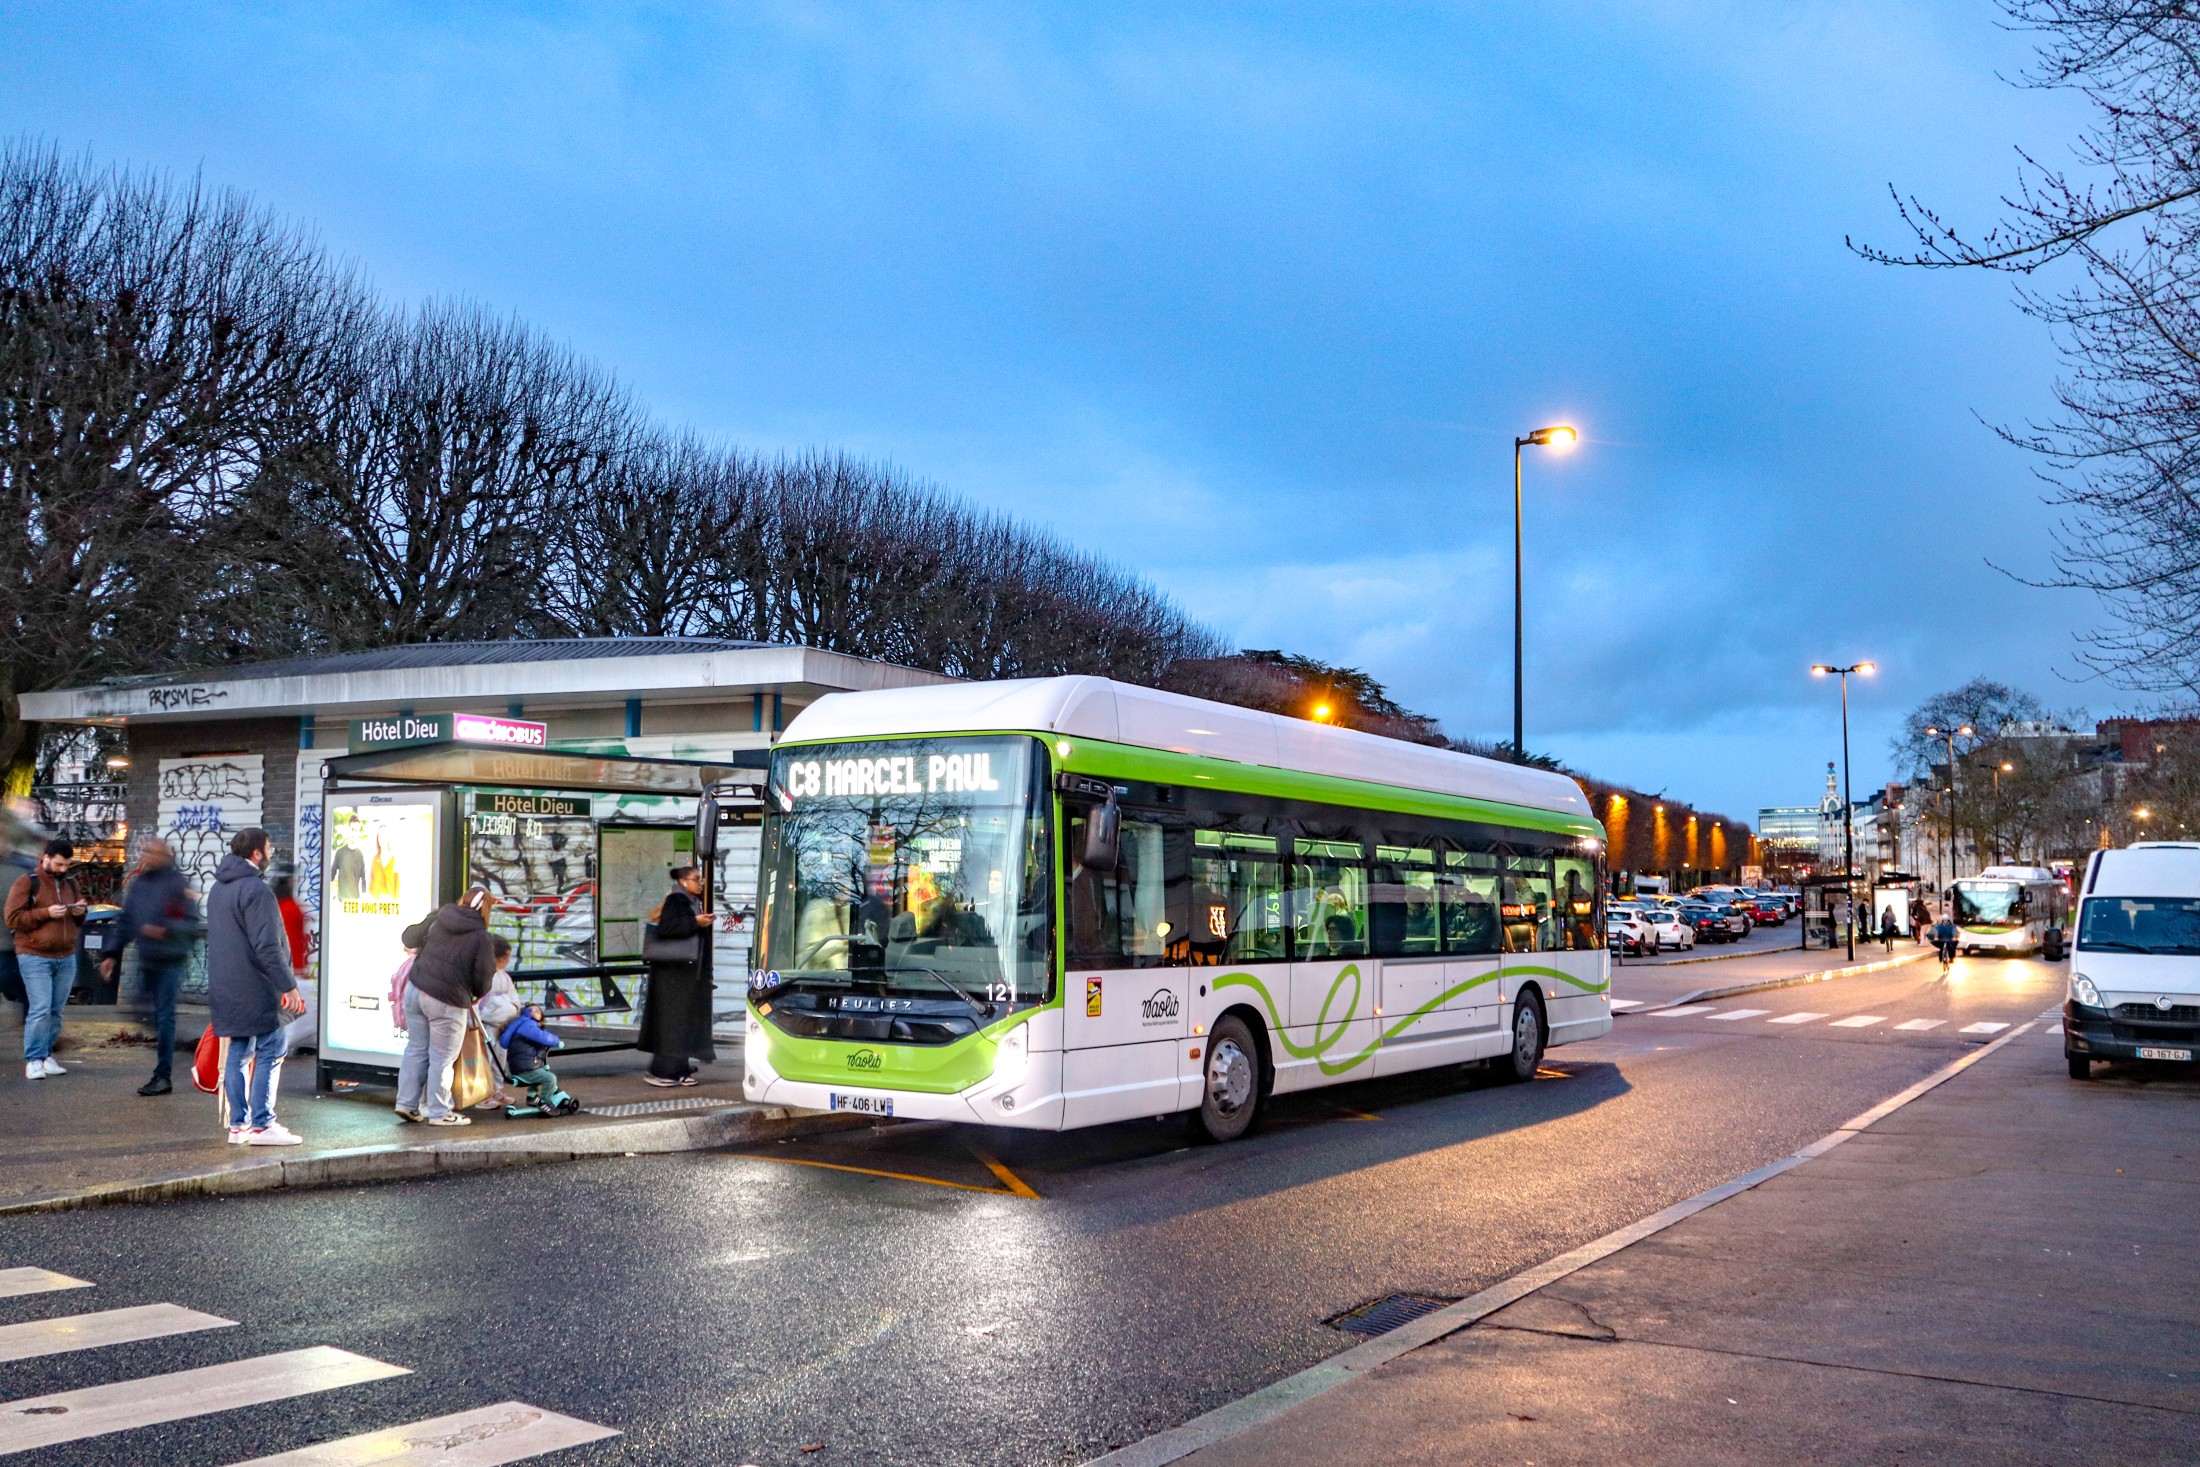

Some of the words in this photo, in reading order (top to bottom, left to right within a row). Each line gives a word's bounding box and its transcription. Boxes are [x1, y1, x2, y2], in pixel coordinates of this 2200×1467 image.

[362, 720, 401, 741] Hôtel
[405, 719, 438, 740] Dieu
[789, 762, 820, 797] C8
[825, 757, 921, 796] MARCEL
[929, 753, 998, 793] PAUL
[494, 795, 536, 812] Hôtel
[540, 798, 574, 814] Dieu
[985, 983, 1017, 1002] 121
[829, 998, 912, 1011] HEULIEZ
